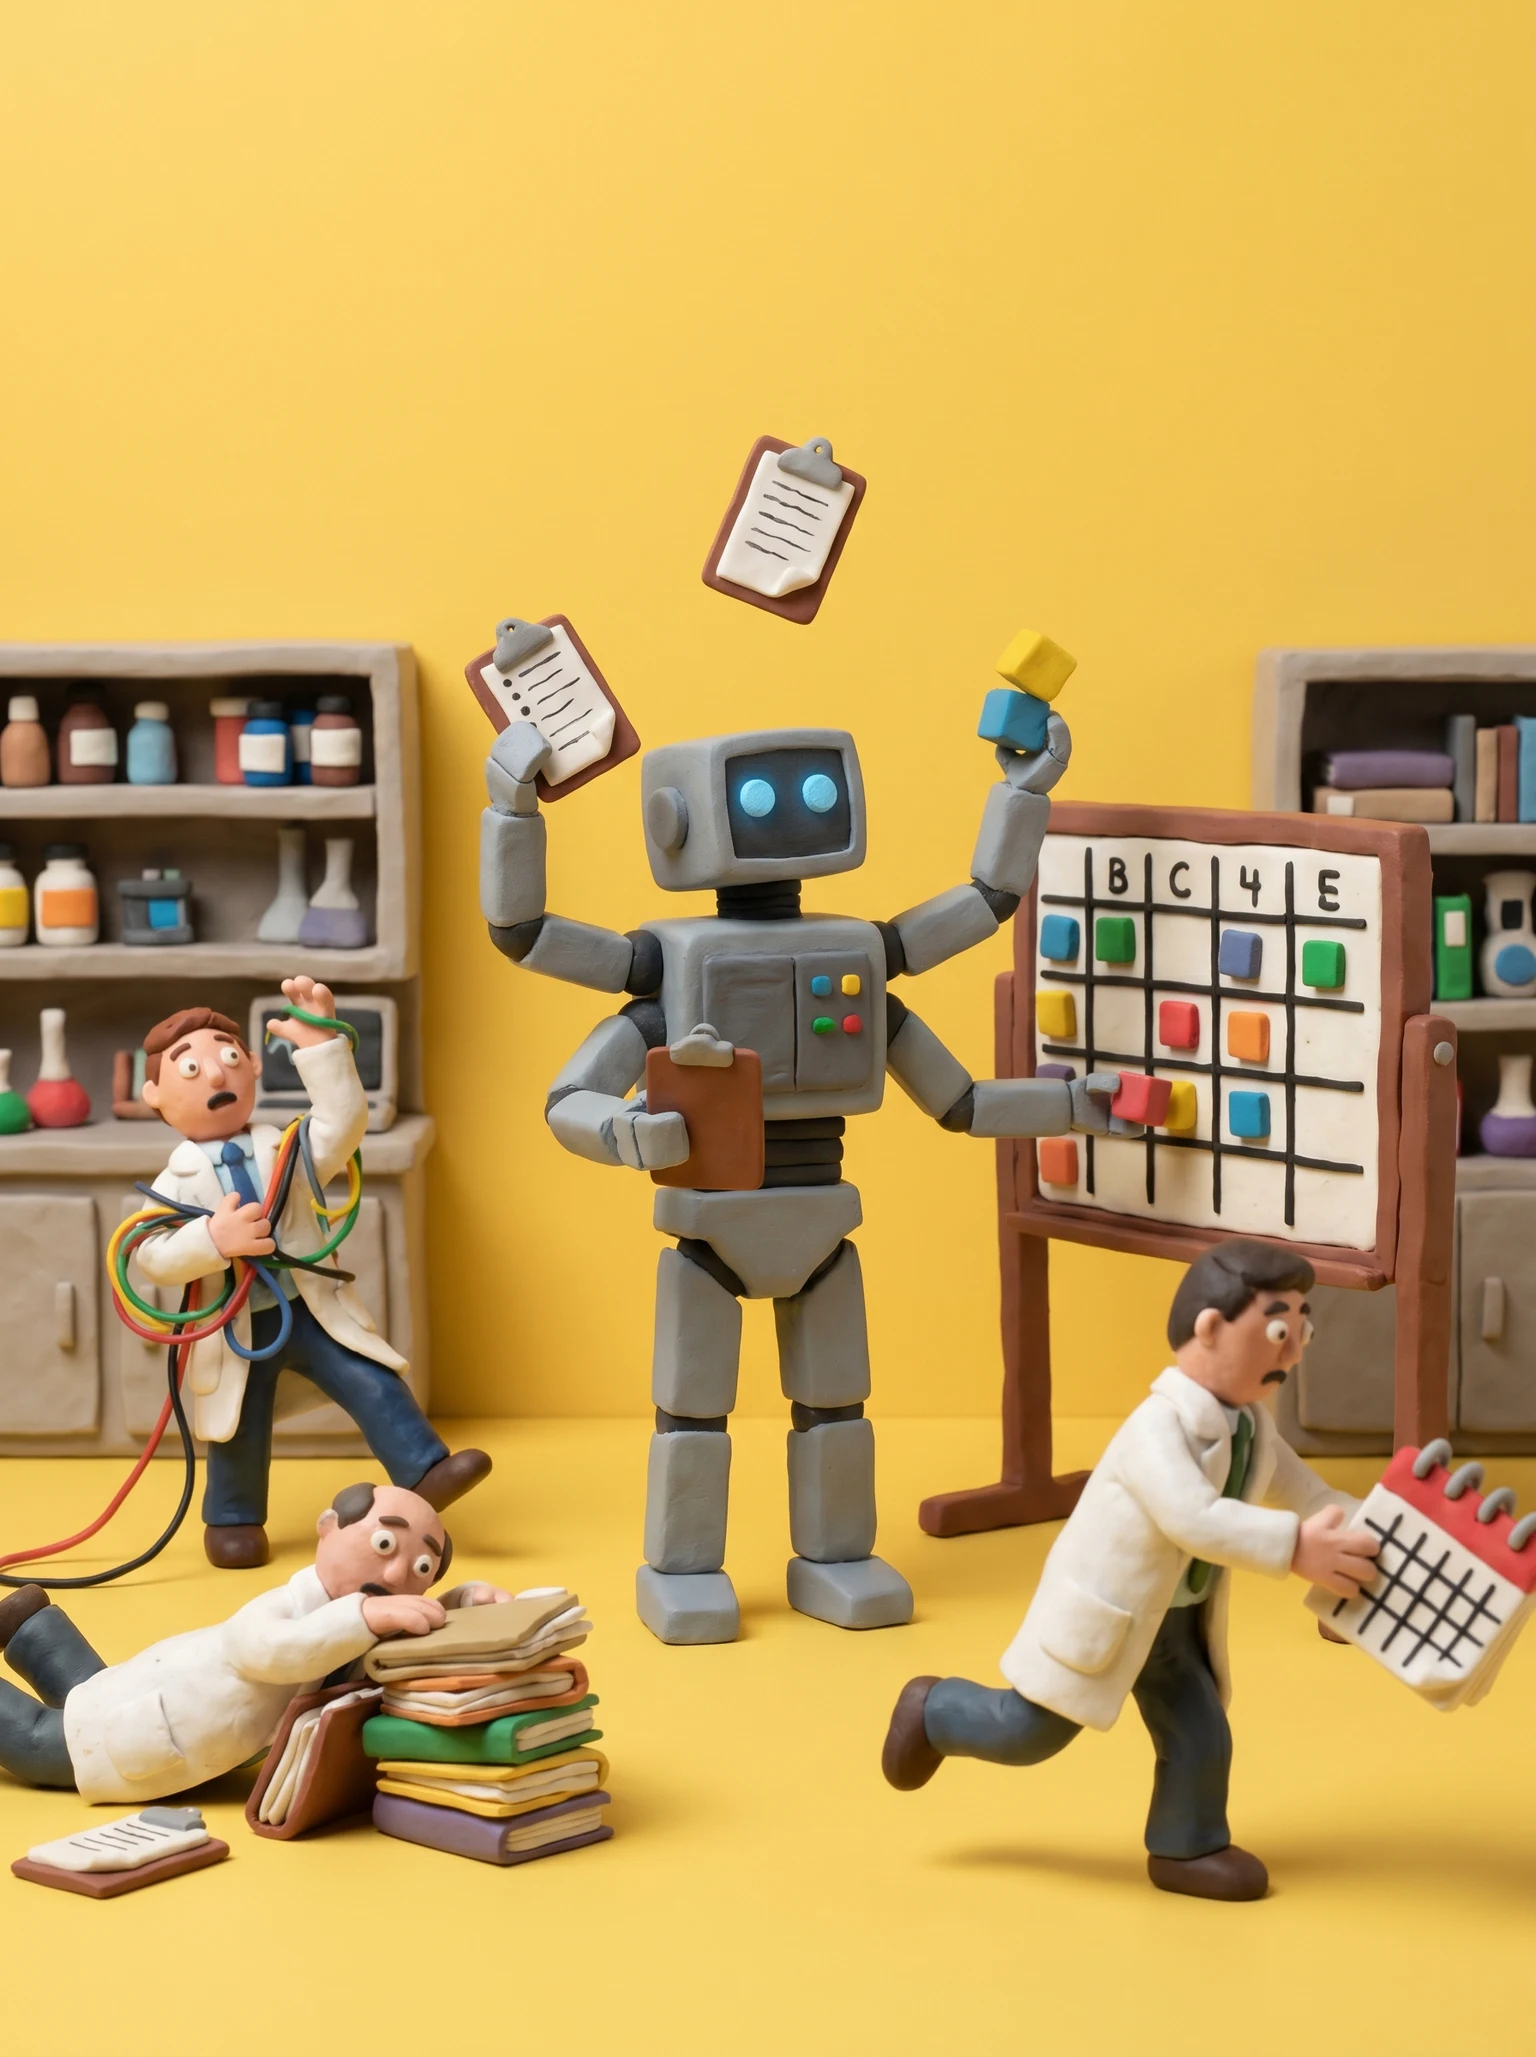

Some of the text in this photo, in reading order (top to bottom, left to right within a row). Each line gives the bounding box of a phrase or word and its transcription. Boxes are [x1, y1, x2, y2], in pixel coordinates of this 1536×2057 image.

[1109, 857, 1340, 911] B C 4 E
